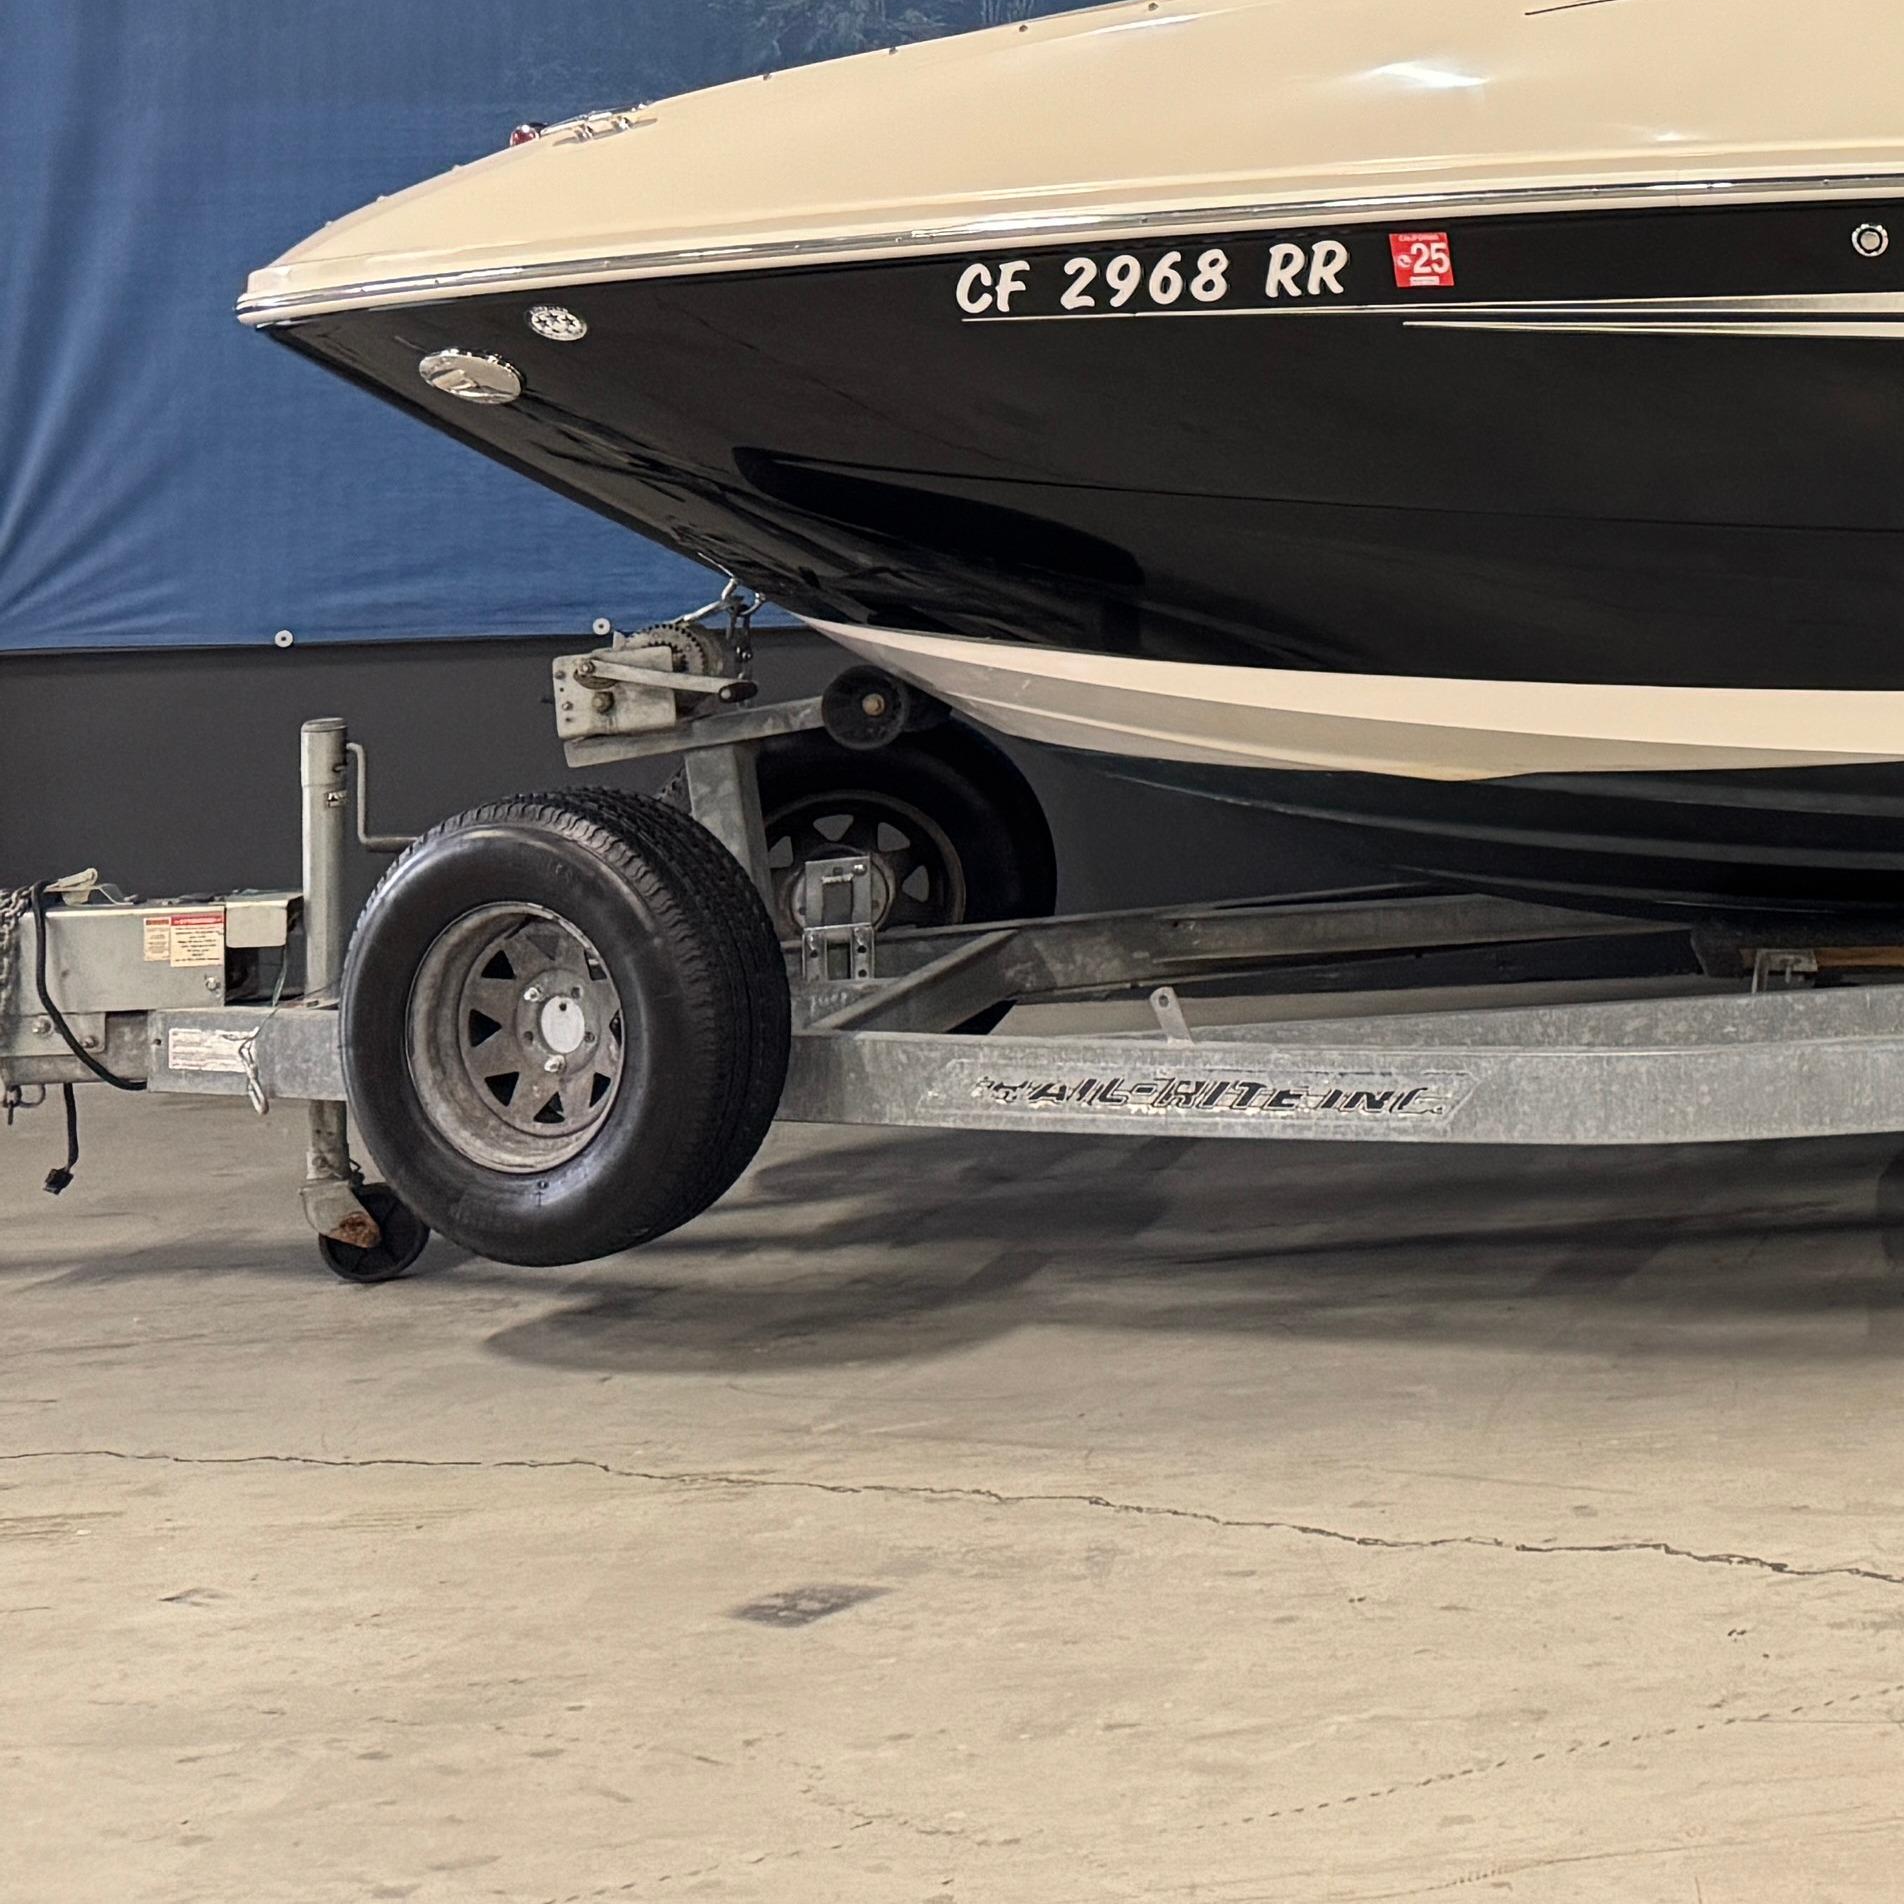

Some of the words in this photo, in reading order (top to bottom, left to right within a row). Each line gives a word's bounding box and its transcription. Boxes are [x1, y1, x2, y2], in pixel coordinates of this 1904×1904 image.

[955, 259, 1031, 314] CF
[1060, 248, 1229, 310] 2968
[1265, 239, 1348, 298] RR
[1410, 242, 1451, 274] 25
